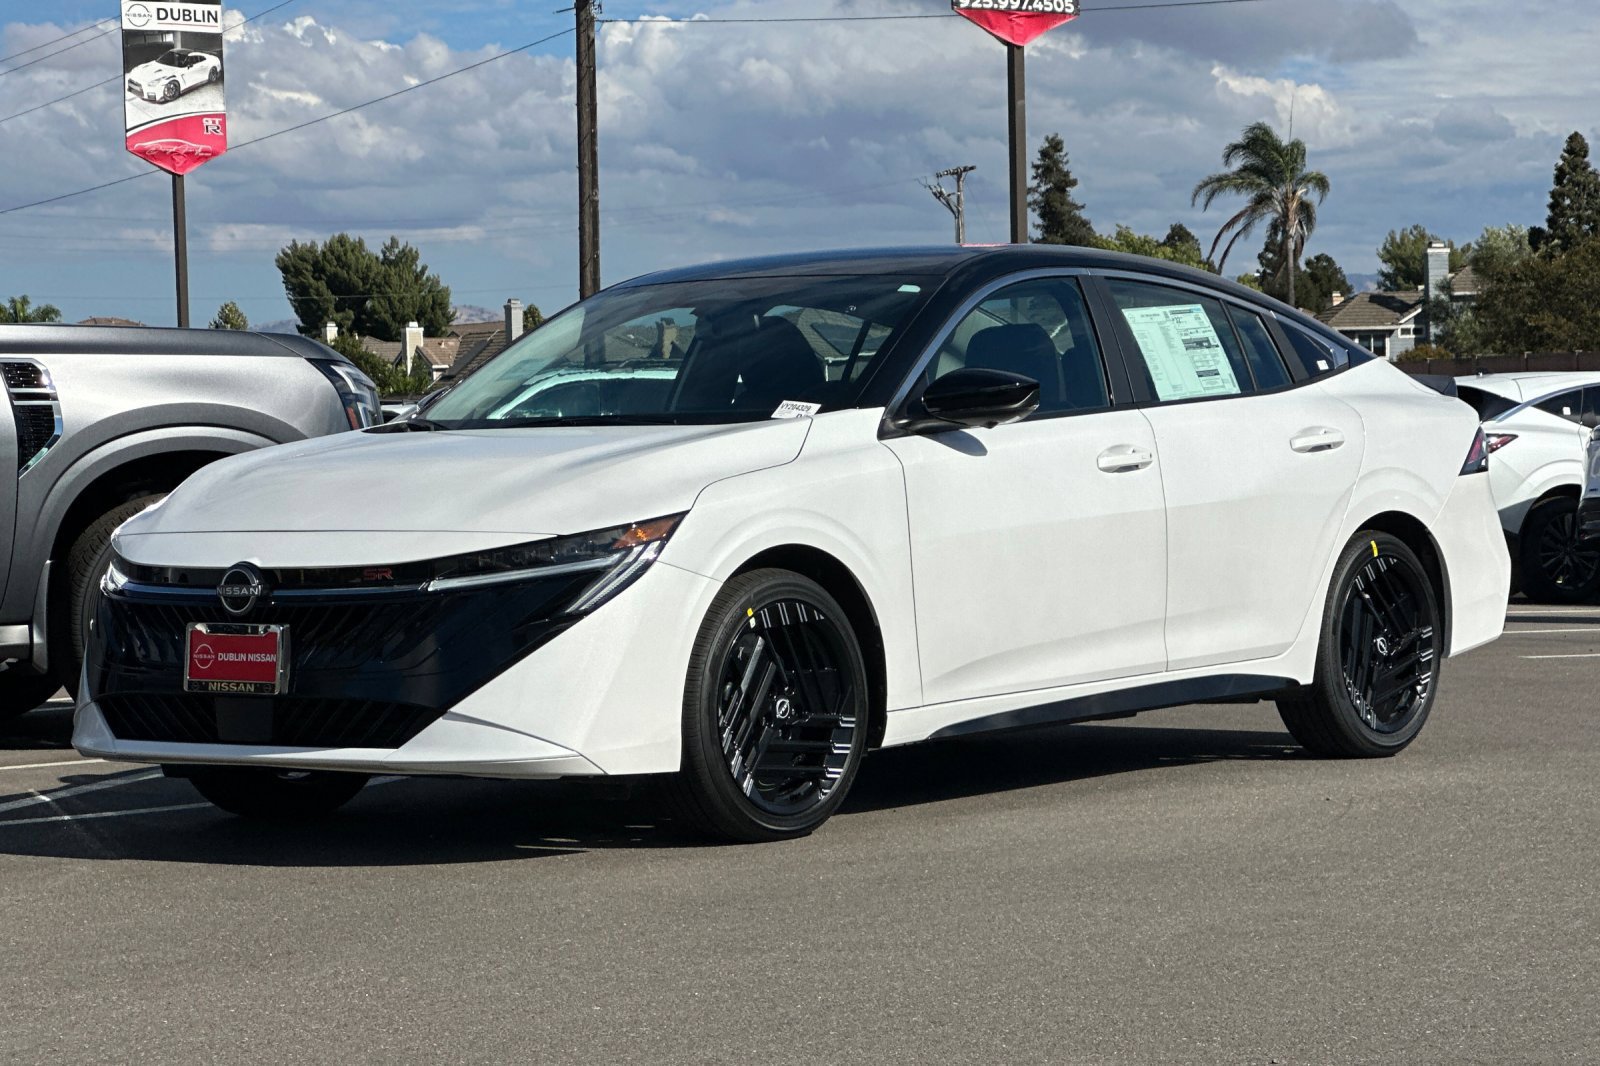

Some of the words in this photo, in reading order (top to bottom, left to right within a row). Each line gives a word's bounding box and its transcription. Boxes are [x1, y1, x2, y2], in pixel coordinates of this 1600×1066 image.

[156, 7, 219, 23] DUBLIN
[363, 567, 394, 581] SR
[216, 586, 260, 596] NISSAN
[217, 652, 247, 662] DUBLIN
[247, 653, 277, 663] NISSAN
[208, 682, 255, 693] NISSAN
